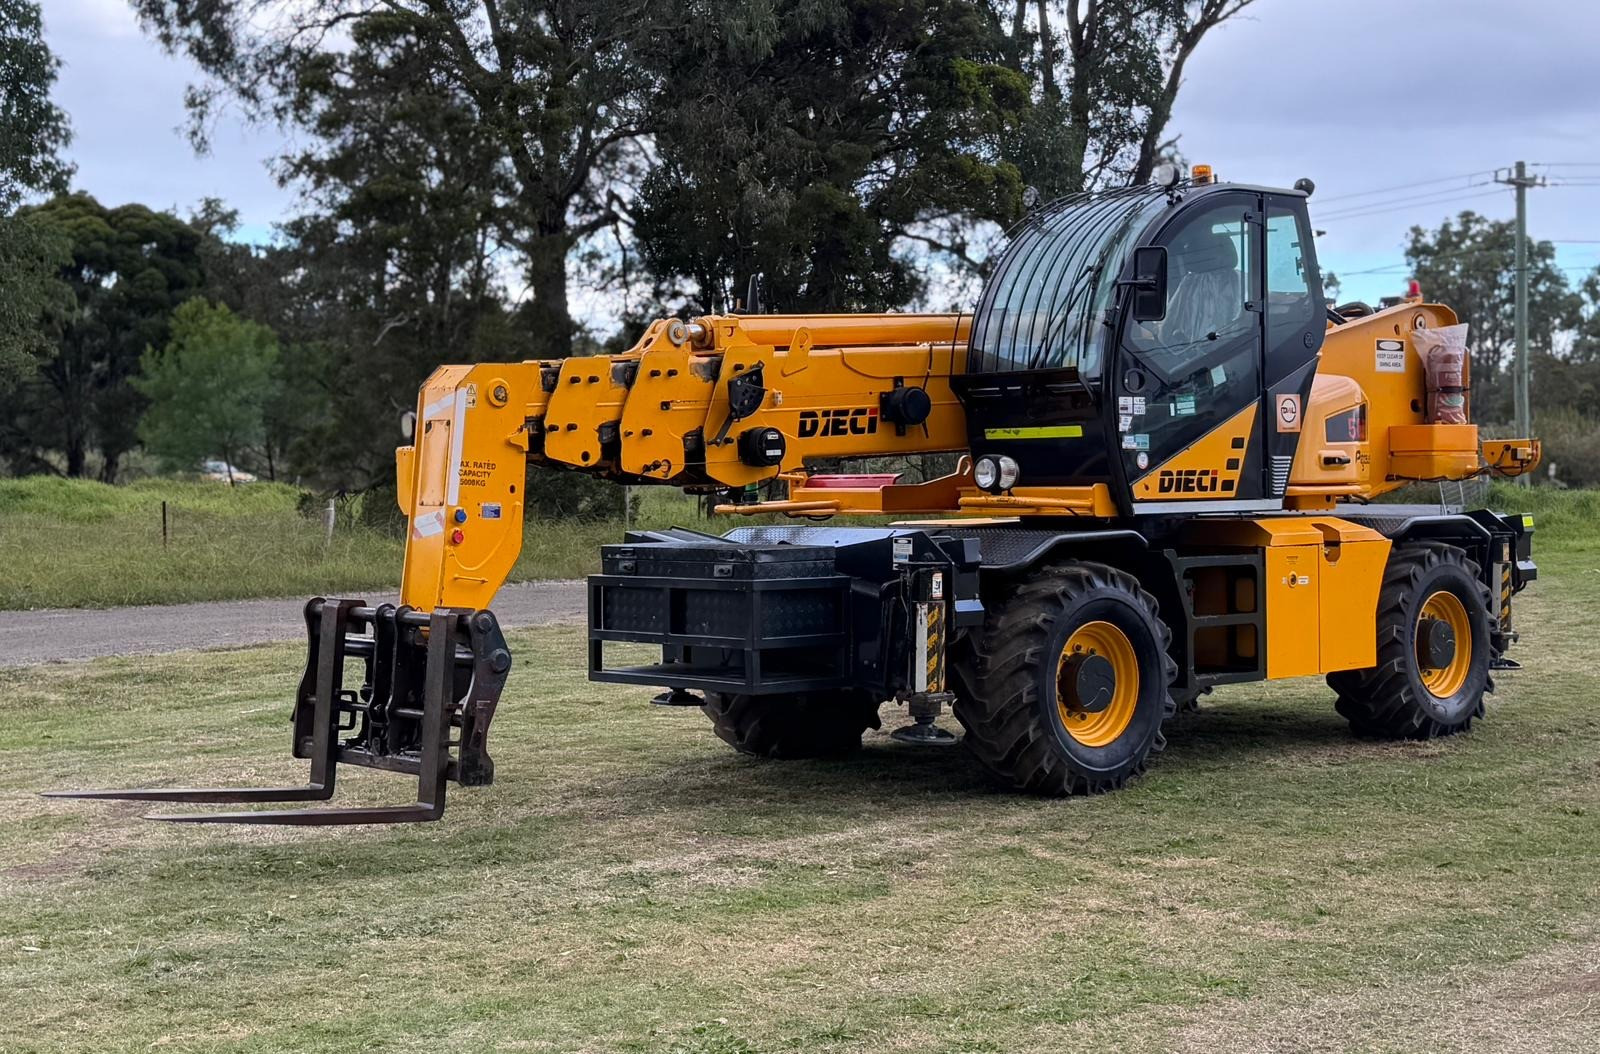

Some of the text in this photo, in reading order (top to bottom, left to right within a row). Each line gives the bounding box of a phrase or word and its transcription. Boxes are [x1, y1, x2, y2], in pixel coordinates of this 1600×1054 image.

[798, 408, 878, 438] DIECI
[458, 469, 492, 478] CAPACITY
[473, 462, 496, 470] RATED
[1159, 470, 1218, 493] DIECI
